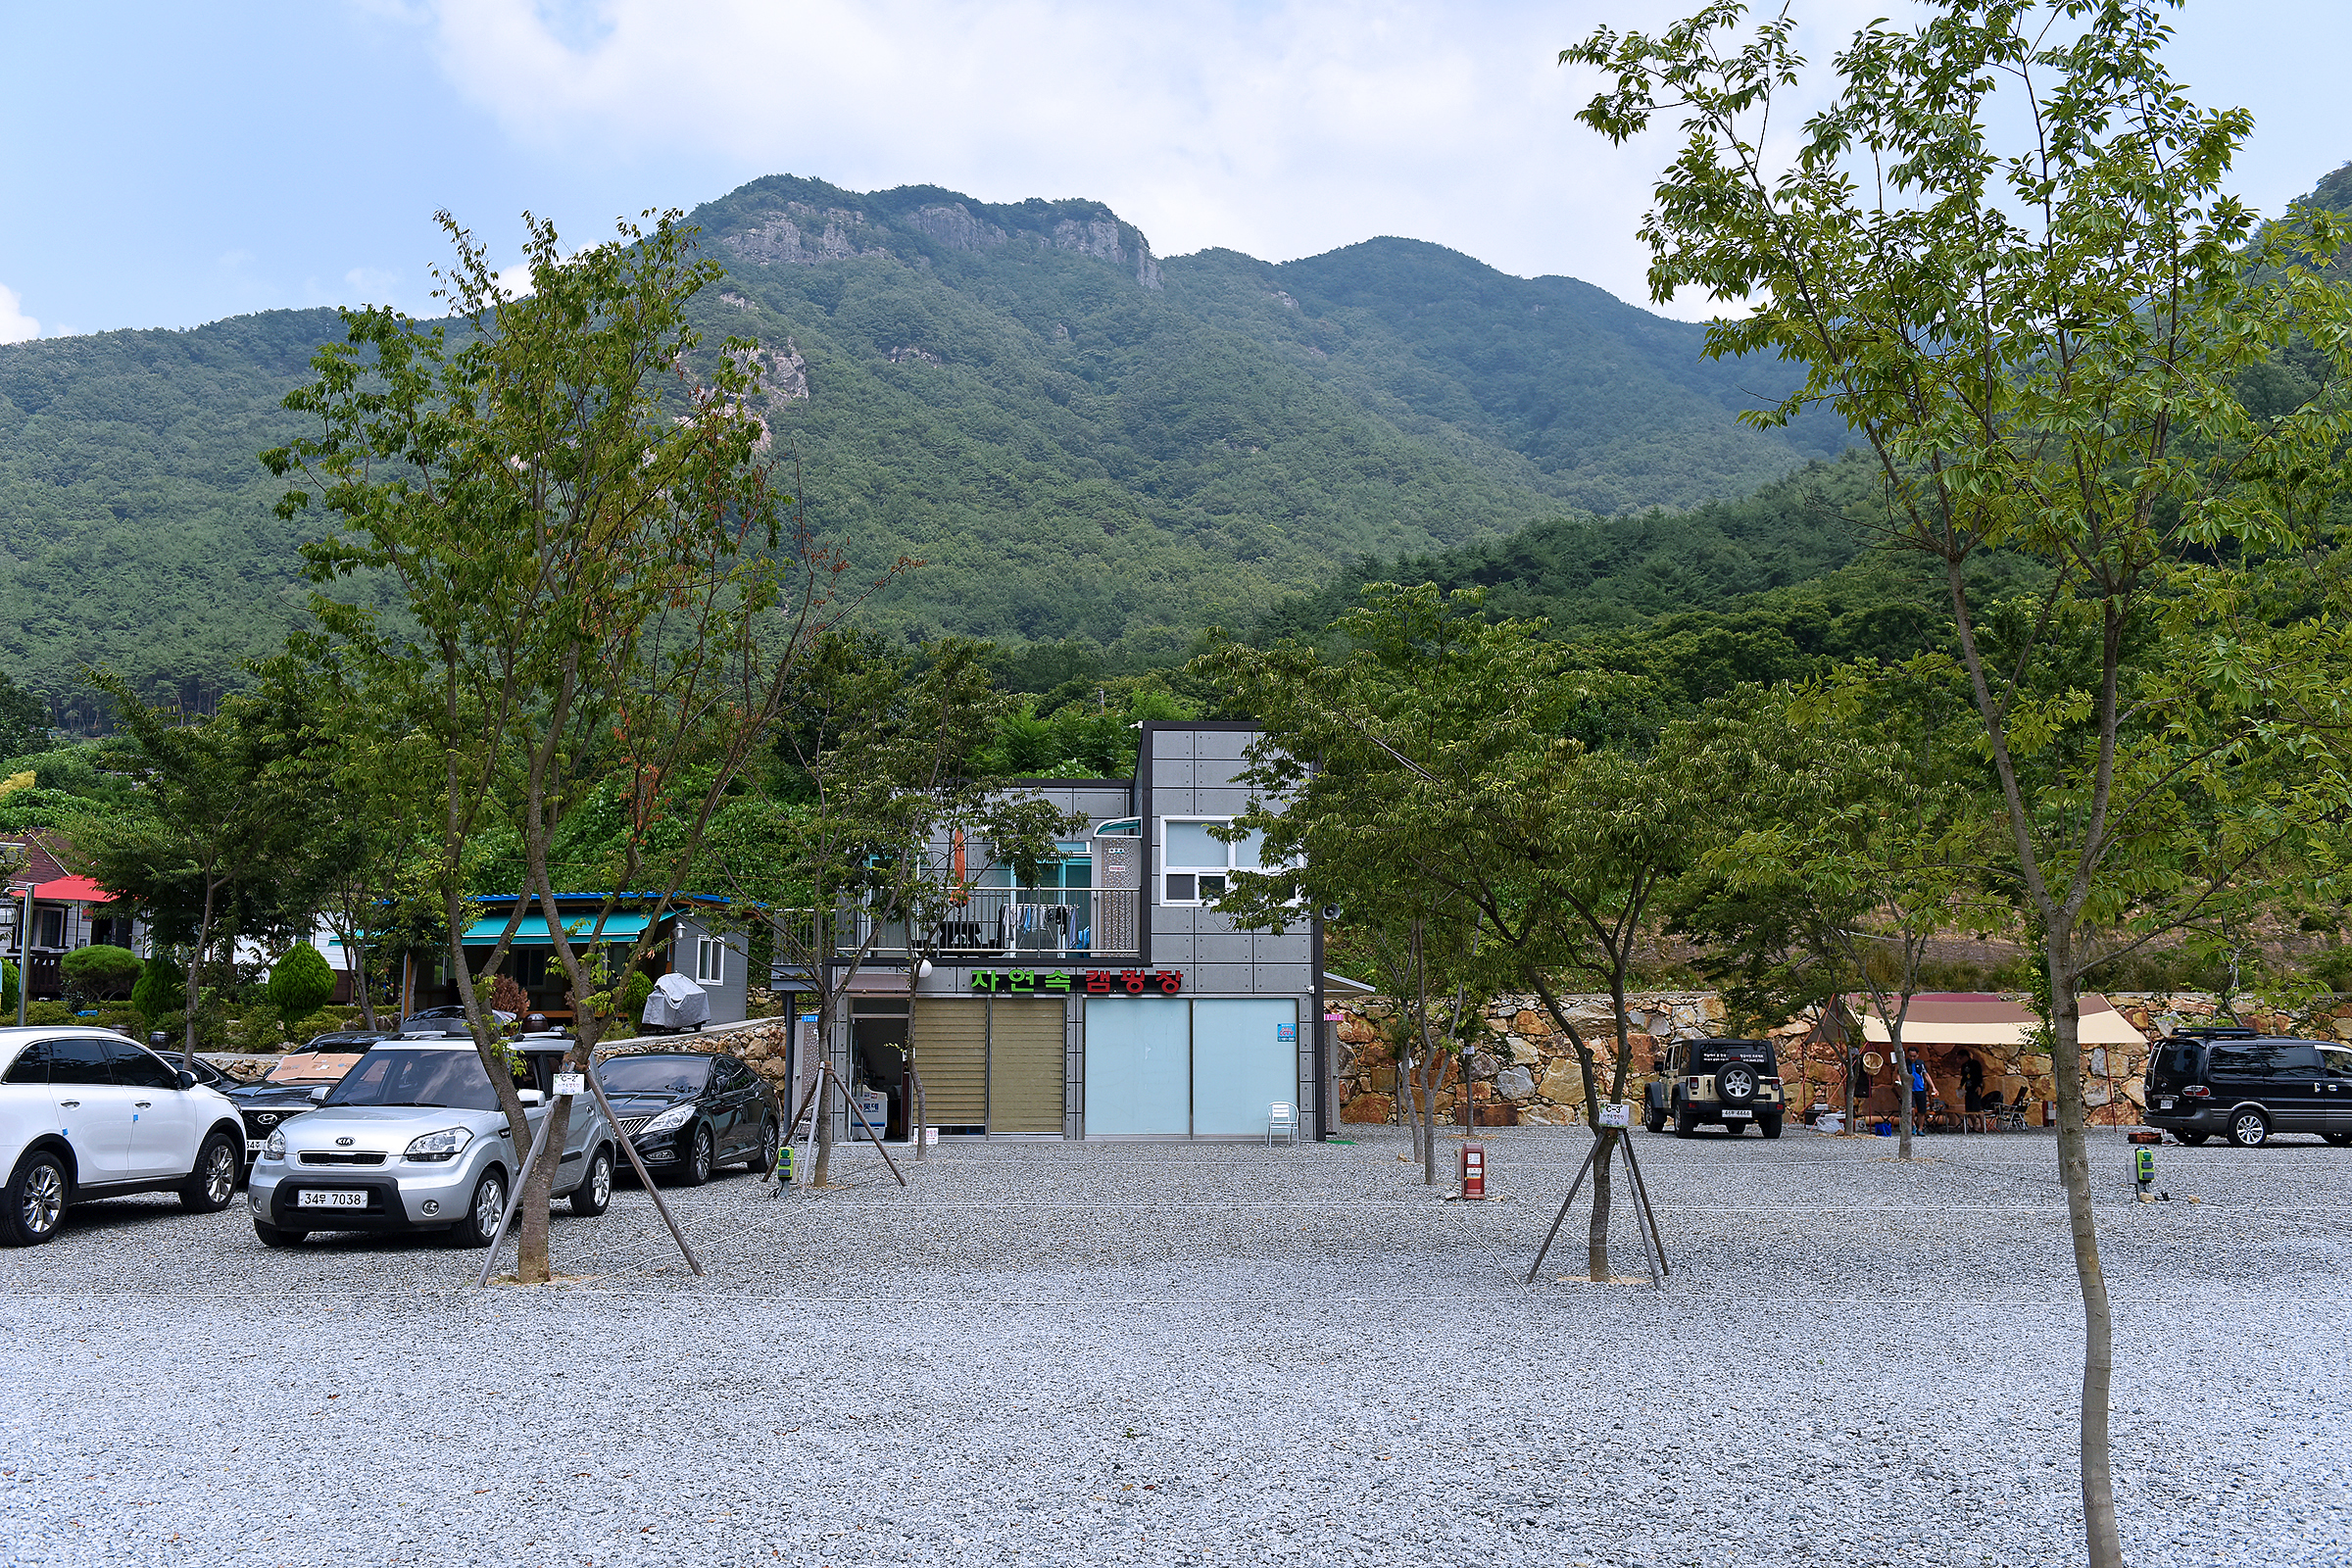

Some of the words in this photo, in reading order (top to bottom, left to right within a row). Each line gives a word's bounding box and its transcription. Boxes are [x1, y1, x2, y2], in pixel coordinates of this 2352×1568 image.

[970, 968, 1071, 992] 자연속
[1085, 969, 1184, 994] 캠핑장
[561, 1074, 576, 1083] C-2
[1605, 1104, 1621, 1113] C-3
[304, 1193, 326, 1204] 34무
[331, 1193, 362, 1205] 7038
